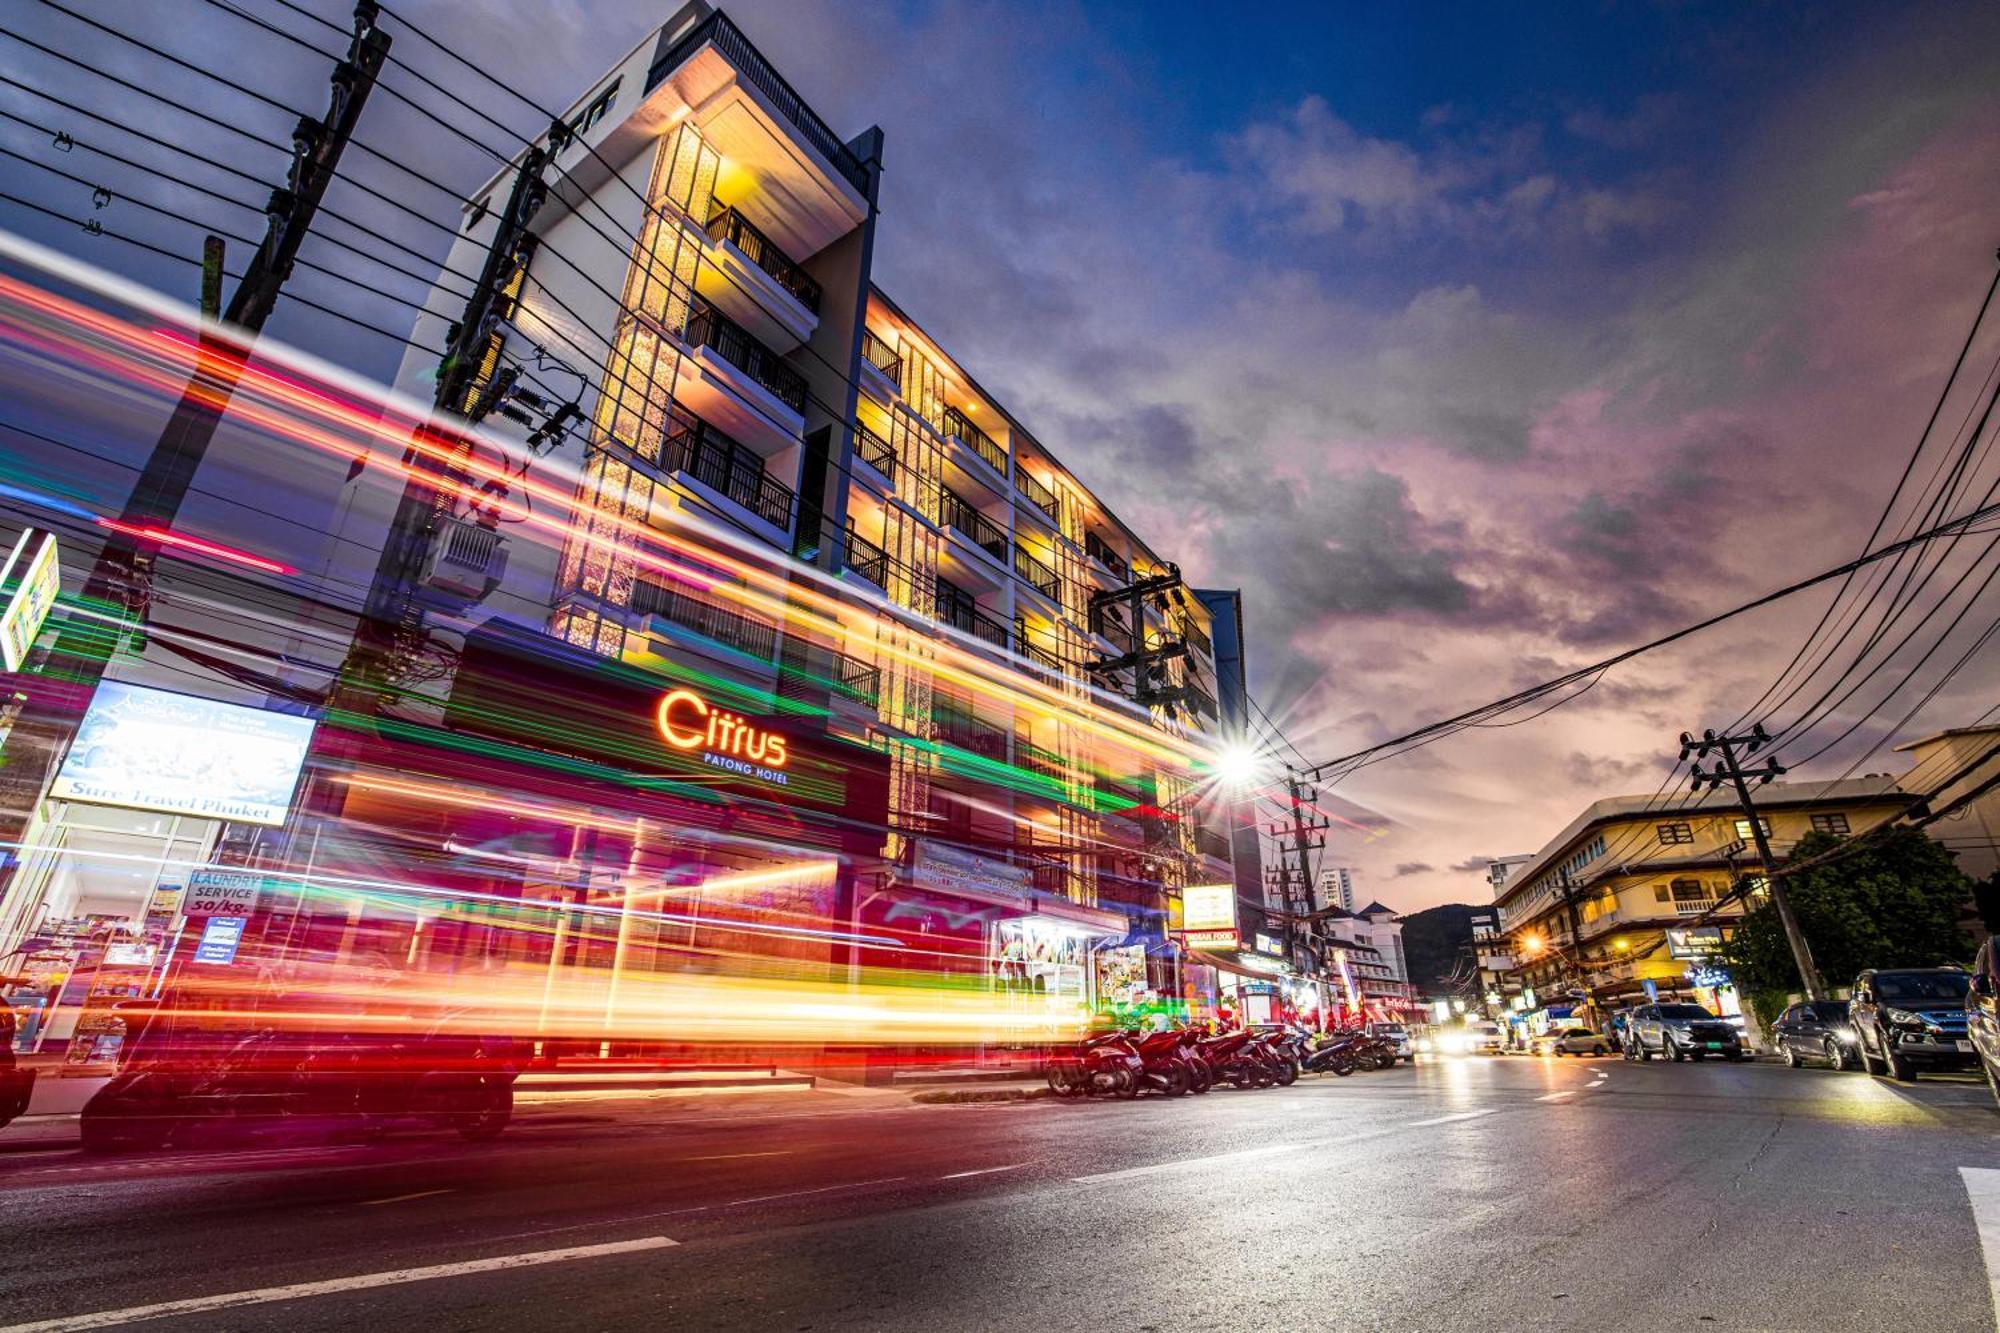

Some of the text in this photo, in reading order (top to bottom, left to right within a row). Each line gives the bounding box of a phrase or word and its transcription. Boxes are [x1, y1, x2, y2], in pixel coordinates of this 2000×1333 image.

[658, 690, 787, 766] Citrus
[704, 752, 788, 785] PATONG HOTEL
[69, 781, 270, 819] Sure Travel Phuket
[192, 871, 260, 888] LAUNDRY
[195, 887, 253, 899] SERVICE
[191, 899, 249, 915] 50/kg.
[1213, 931, 1233, 941] FOOD
